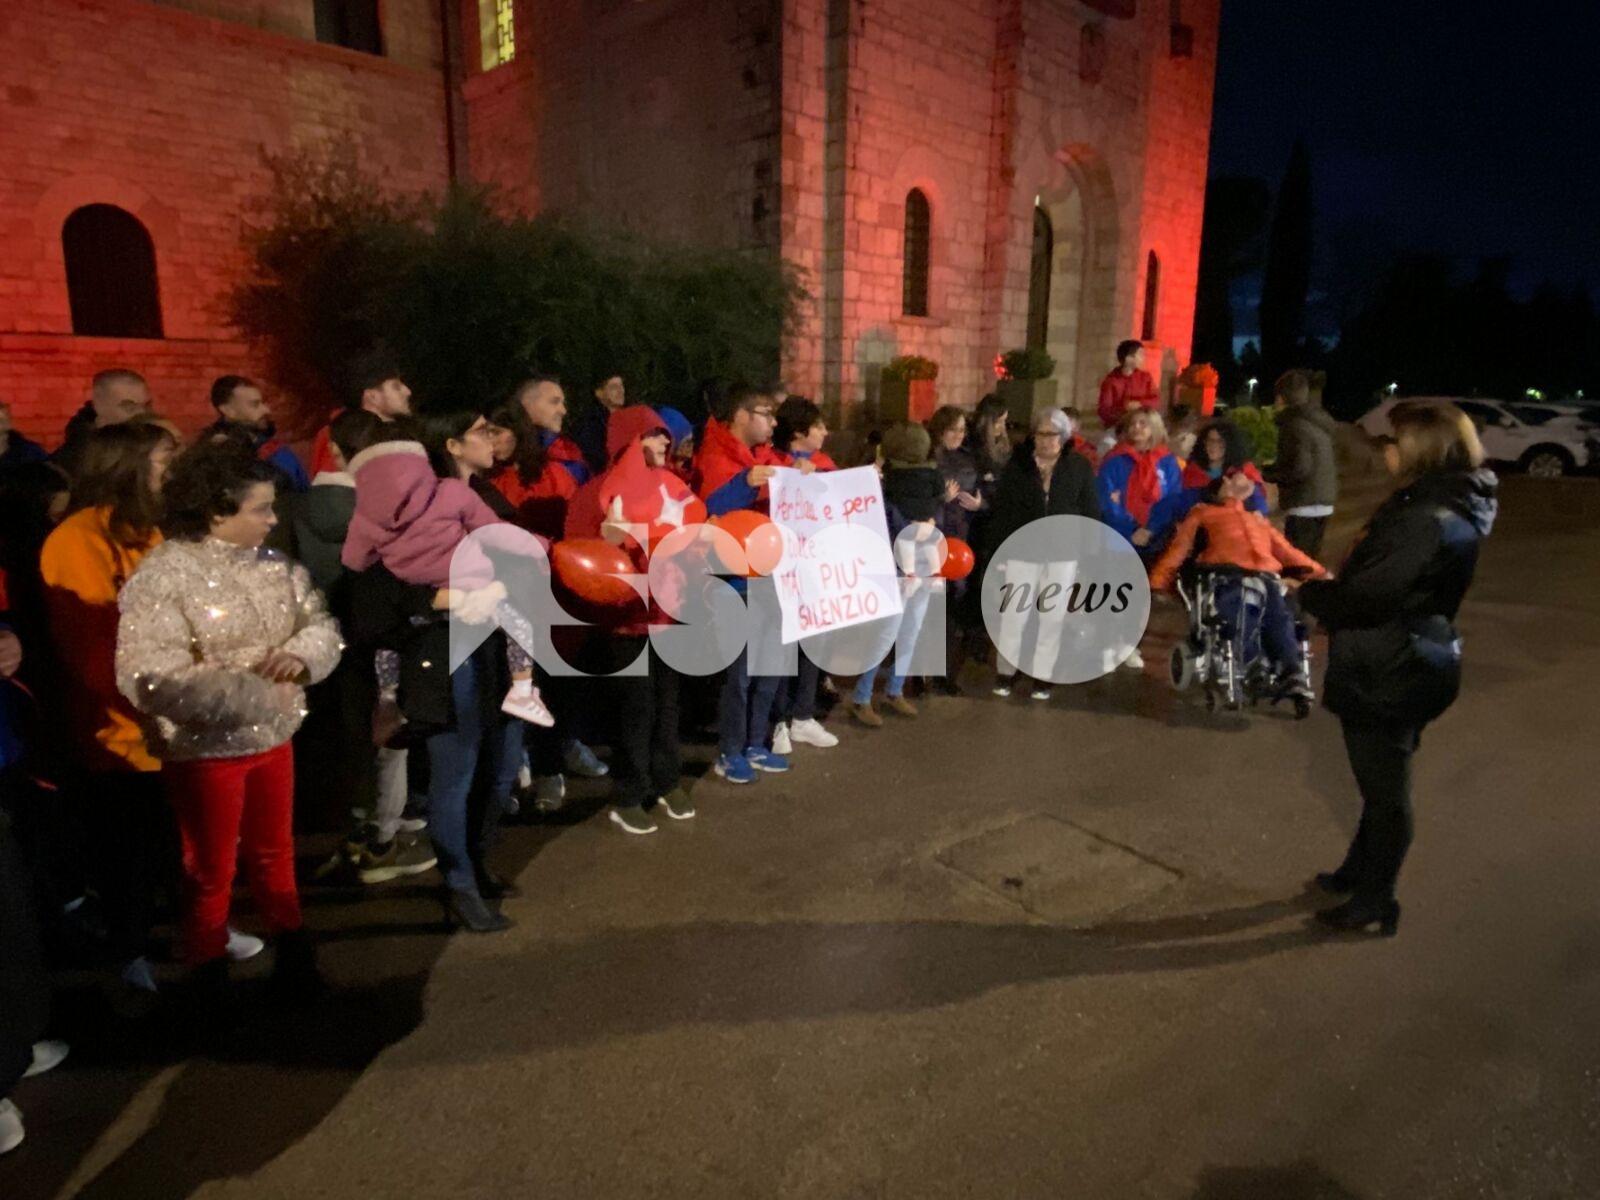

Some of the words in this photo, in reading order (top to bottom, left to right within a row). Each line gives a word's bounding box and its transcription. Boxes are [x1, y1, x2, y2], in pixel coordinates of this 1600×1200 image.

[823, 506, 834, 520] e
[842, 494, 878, 526] per
[798, 591, 879, 631] SILENZIO
